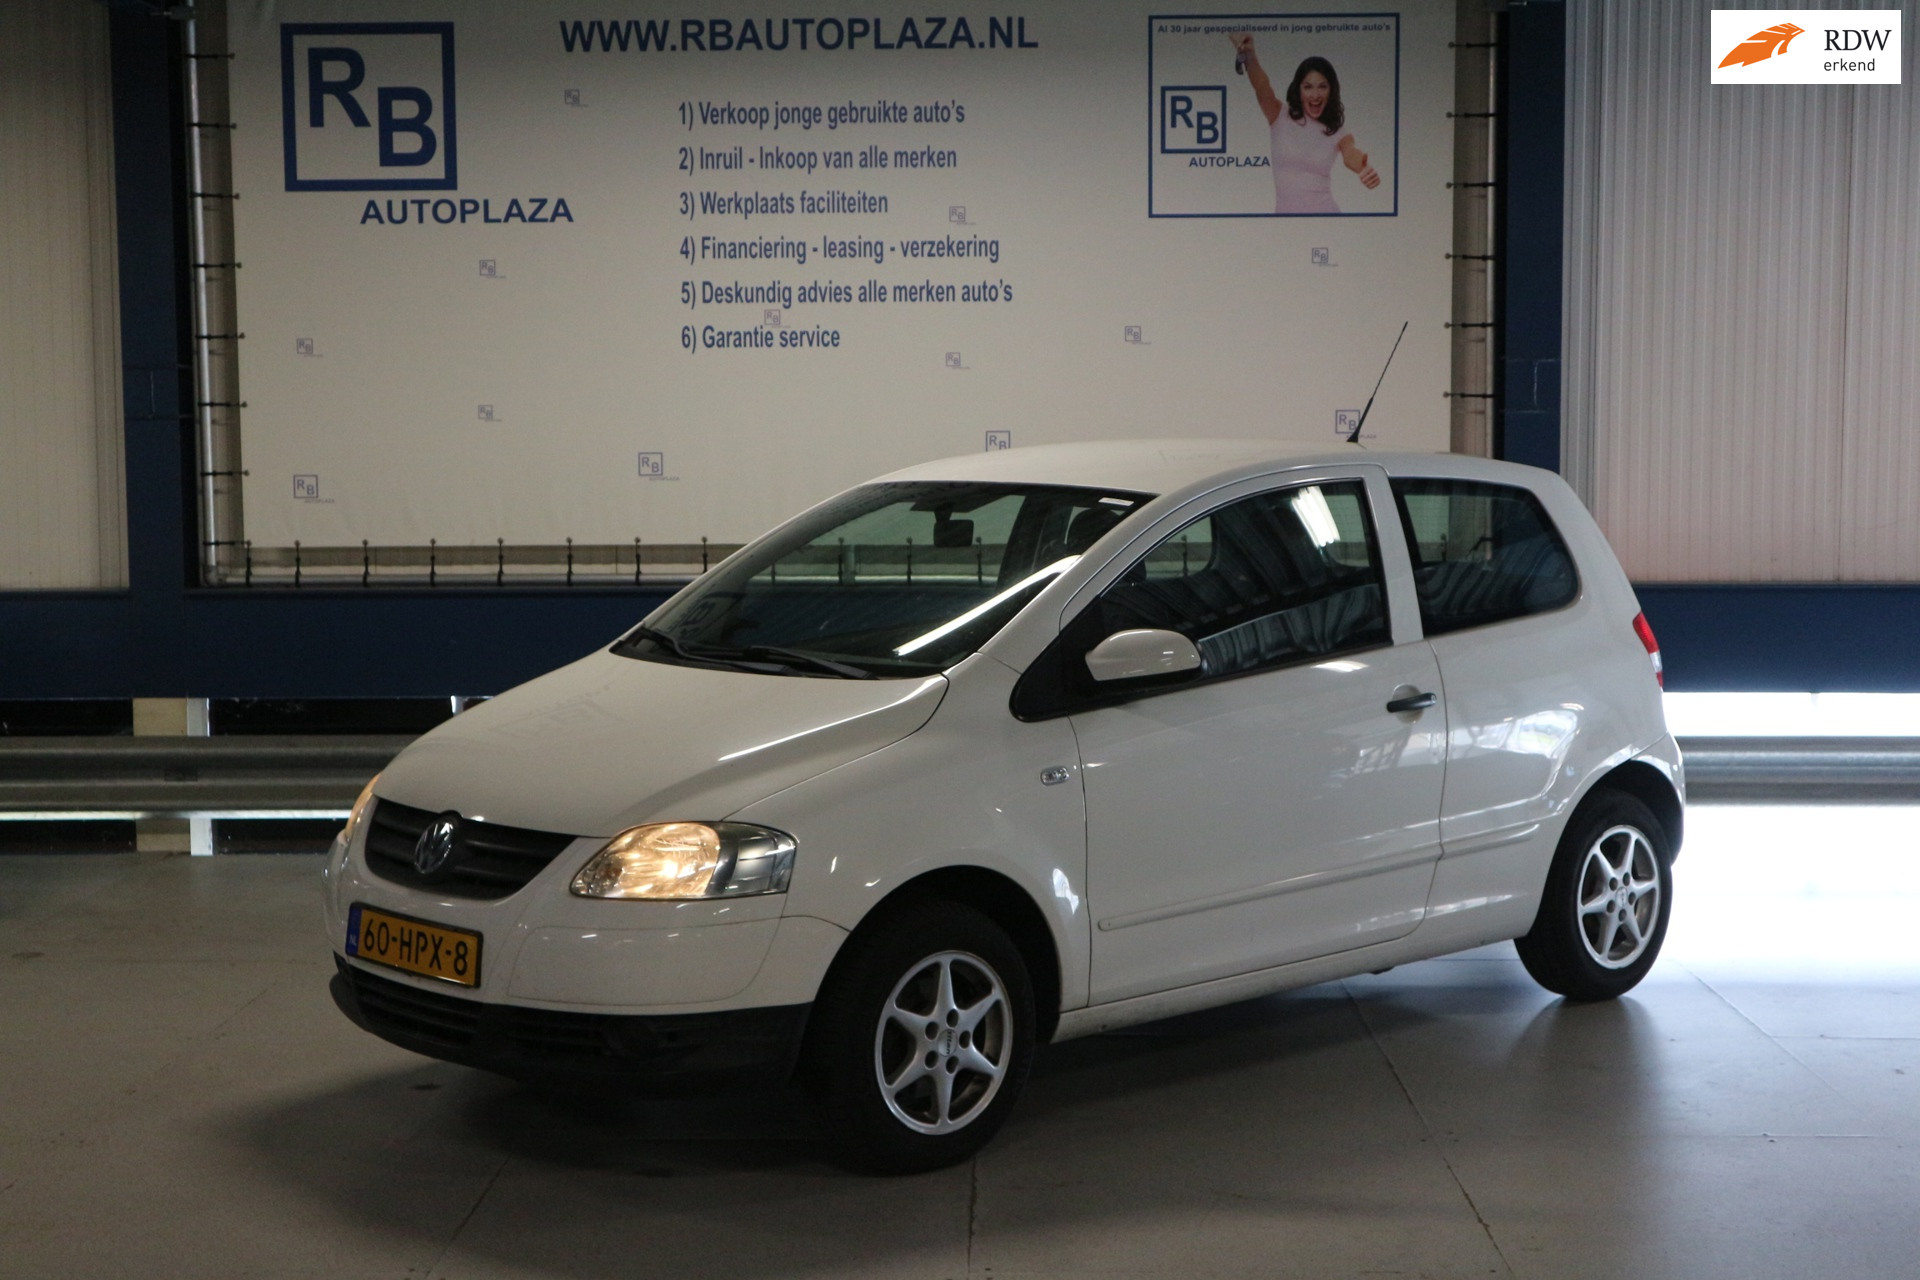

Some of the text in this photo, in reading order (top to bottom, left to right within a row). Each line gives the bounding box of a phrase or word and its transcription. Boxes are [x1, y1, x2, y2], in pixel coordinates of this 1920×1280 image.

[559, 16, 1038, 53] WWW.RBAUTOPLAZA.NL
[1158, 25, 1168, 33] Al
[1171, 25, 1181, 33] 30
[1184, 25, 1201, 35] jaar
[1204, 24, 1278, 34] gespecialiseerd
[1291, 24, 1313, 33] jong
[1315, 24, 1359, 33] gebruikte
[307, 47, 437, 167] RB
[679, 102, 693, 130] 1)
[698, 101, 769, 129] Verkoop
[774, 101, 822, 130] jonge
[828, 100, 908, 130] gebruikte
[1171, 95, 1219, 144] RB
[679, 147, 694, 176] 2)
[700, 147, 742, 169] Inruil
[760, 146, 817, 174] Inkoop
[823, 151, 853, 168] van
[859, 145, 888, 168] alle
[894, 145, 956, 168] merken
[1189, 156, 1270, 167] AUTOPLAZA
[360, 198, 573, 224] AUTOPLAZA
[680, 190, 888, 220] 3) Werkplaats faciliteiten
[680, 237, 695, 264] 4)
[702, 236, 806, 264] Financiering
[823, 236, 883, 264] leasing
[901, 235, 999, 263] verzekering
[682, 281, 696, 309] 5)
[702, 281, 792, 309] Deskundig
[798, 280, 852, 303] advies
[858, 280, 887, 302] alle
[893, 280, 955, 302] merken
[682, 325, 840, 353] 6) Garantie service
[1339, 414, 1357, 431] RB
[641, 456, 659, 473] RB
[296, 479, 315, 495] RB
[364, 919, 469, 976] 60-HPX-8
